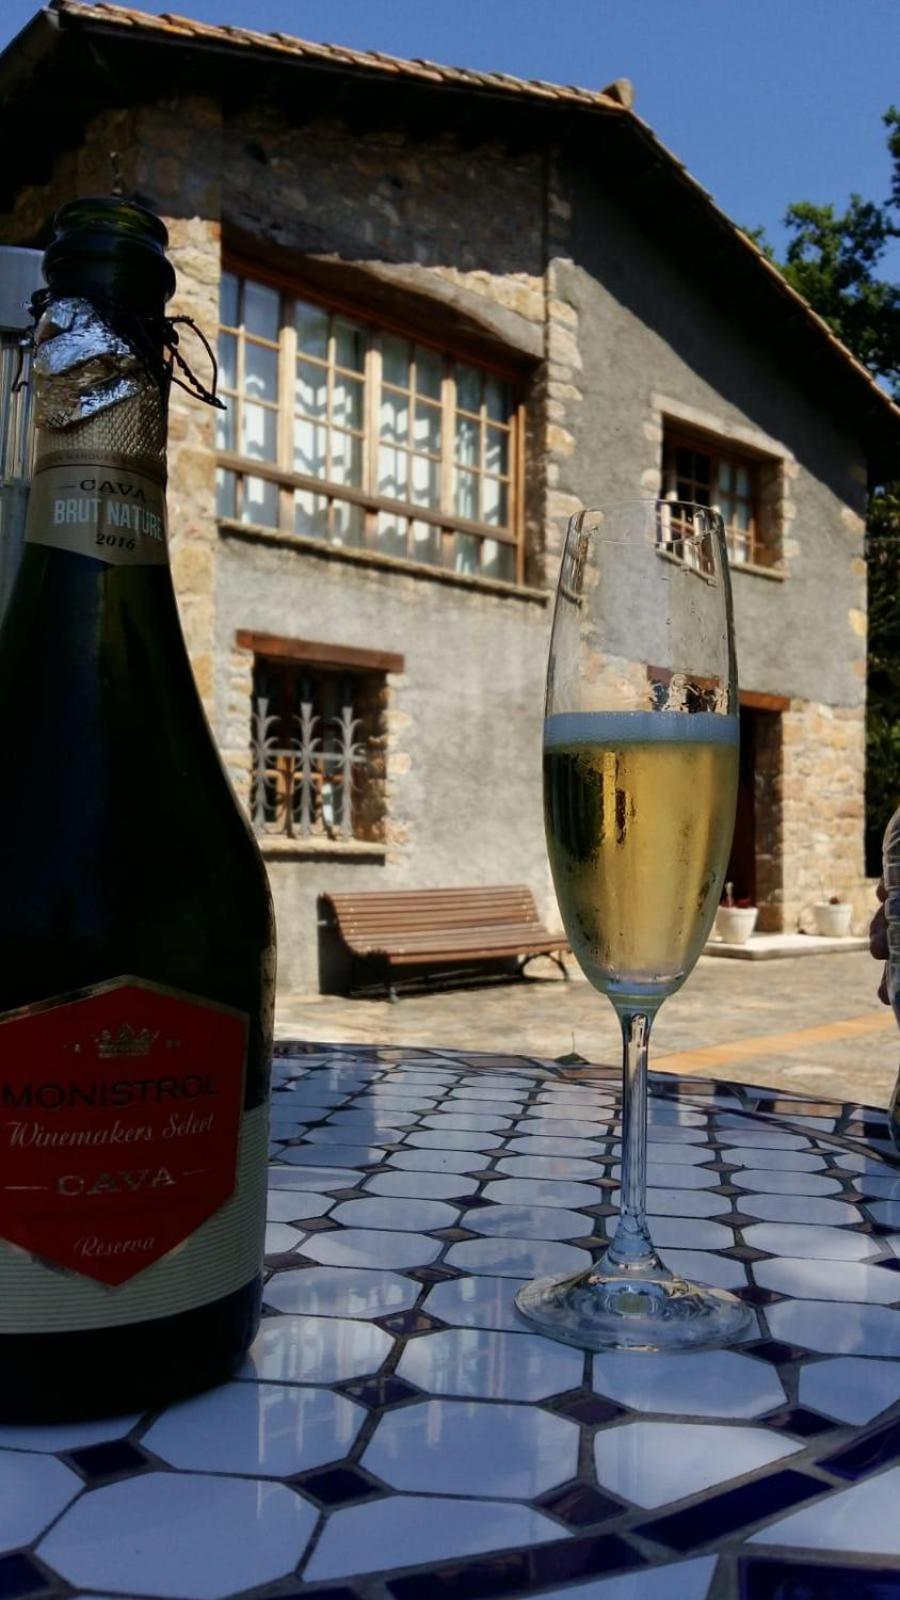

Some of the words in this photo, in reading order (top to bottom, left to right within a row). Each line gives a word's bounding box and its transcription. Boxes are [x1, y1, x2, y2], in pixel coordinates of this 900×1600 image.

[80, 479, 146, 499] CAVA
[54, 498, 101, 524] BRUT
[107, 501, 162, 541] NATURE
[95, 533, 136, 550] 2016
[3, 1074, 220, 1110] MONISTROL
[7, 1120, 153, 1147] Winemakers
[162, 1111, 214, 1138] Select
[56, 1167, 176, 1196] CAVA
[73, 1236, 156, 1257] Reserva
